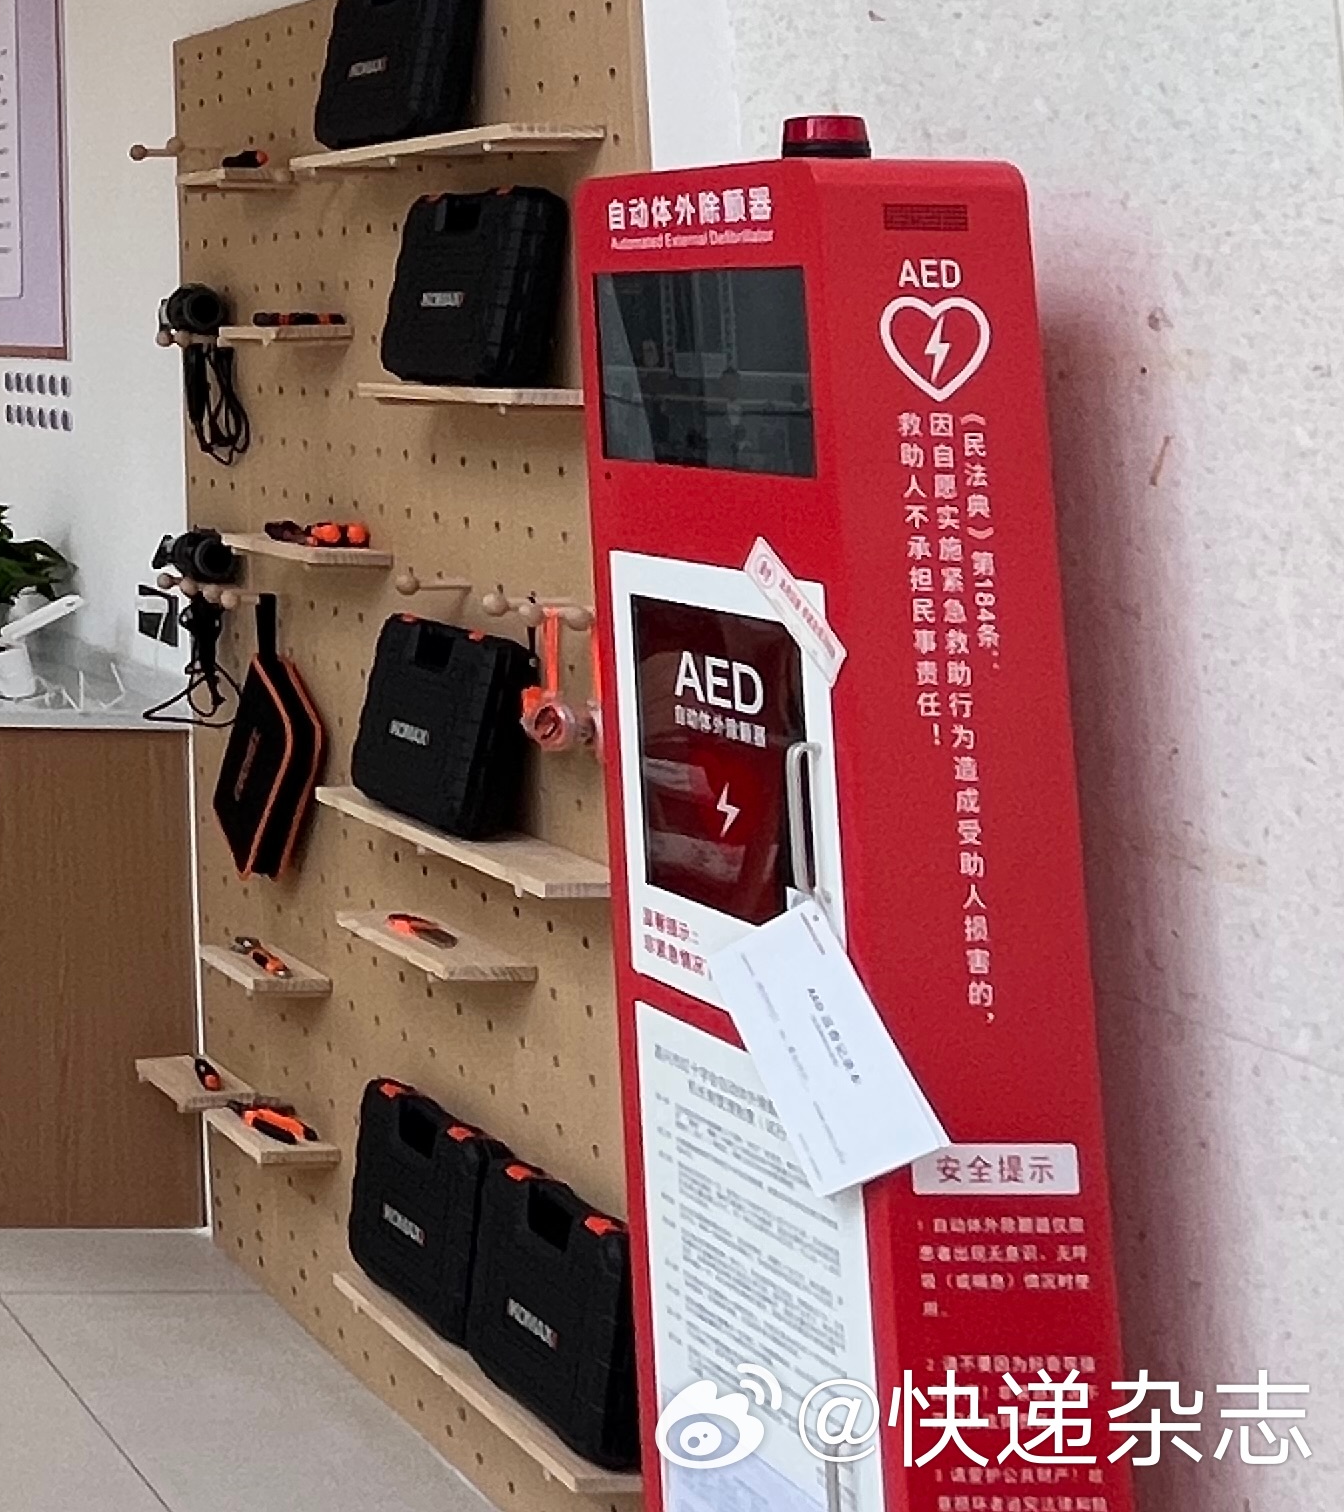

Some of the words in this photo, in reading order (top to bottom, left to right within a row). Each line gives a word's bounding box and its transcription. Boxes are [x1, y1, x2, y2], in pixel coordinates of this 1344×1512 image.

[608, 186, 772, 231] 自动体外除颤器
[898, 259, 962, 288] AED
[674, 650, 764, 714] AED
[936, 1155, 1056, 1185] 安全提示
